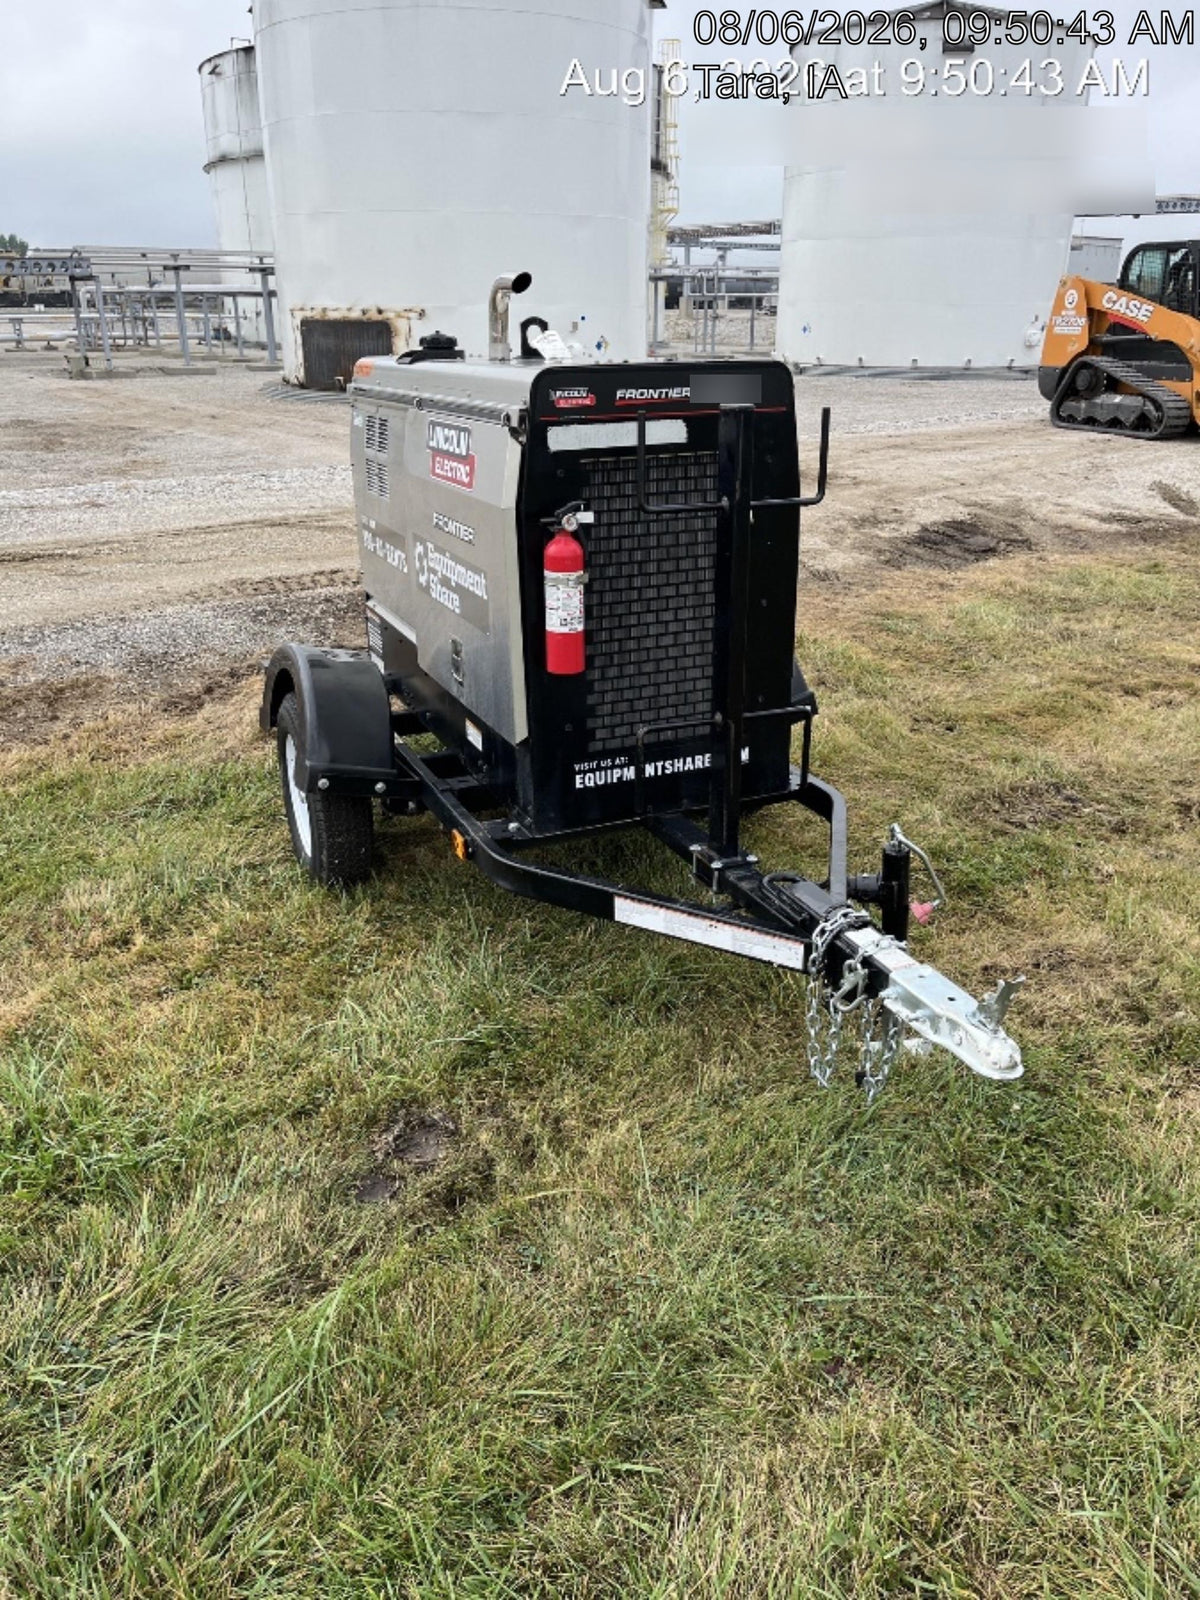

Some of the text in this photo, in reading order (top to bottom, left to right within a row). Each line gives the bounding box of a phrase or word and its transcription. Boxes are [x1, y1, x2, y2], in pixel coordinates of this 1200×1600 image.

[1102, 290, 1154, 322] CASE
[616, 387, 690, 400] FRONTIER
[434, 456, 471, 484] ELECTRIC
[432, 511, 476, 546] FRONTIER
[426, 541, 488, 600] Equipment
[429, 573, 462, 614] Share
[574, 756, 629, 771] VISIT US AT:
